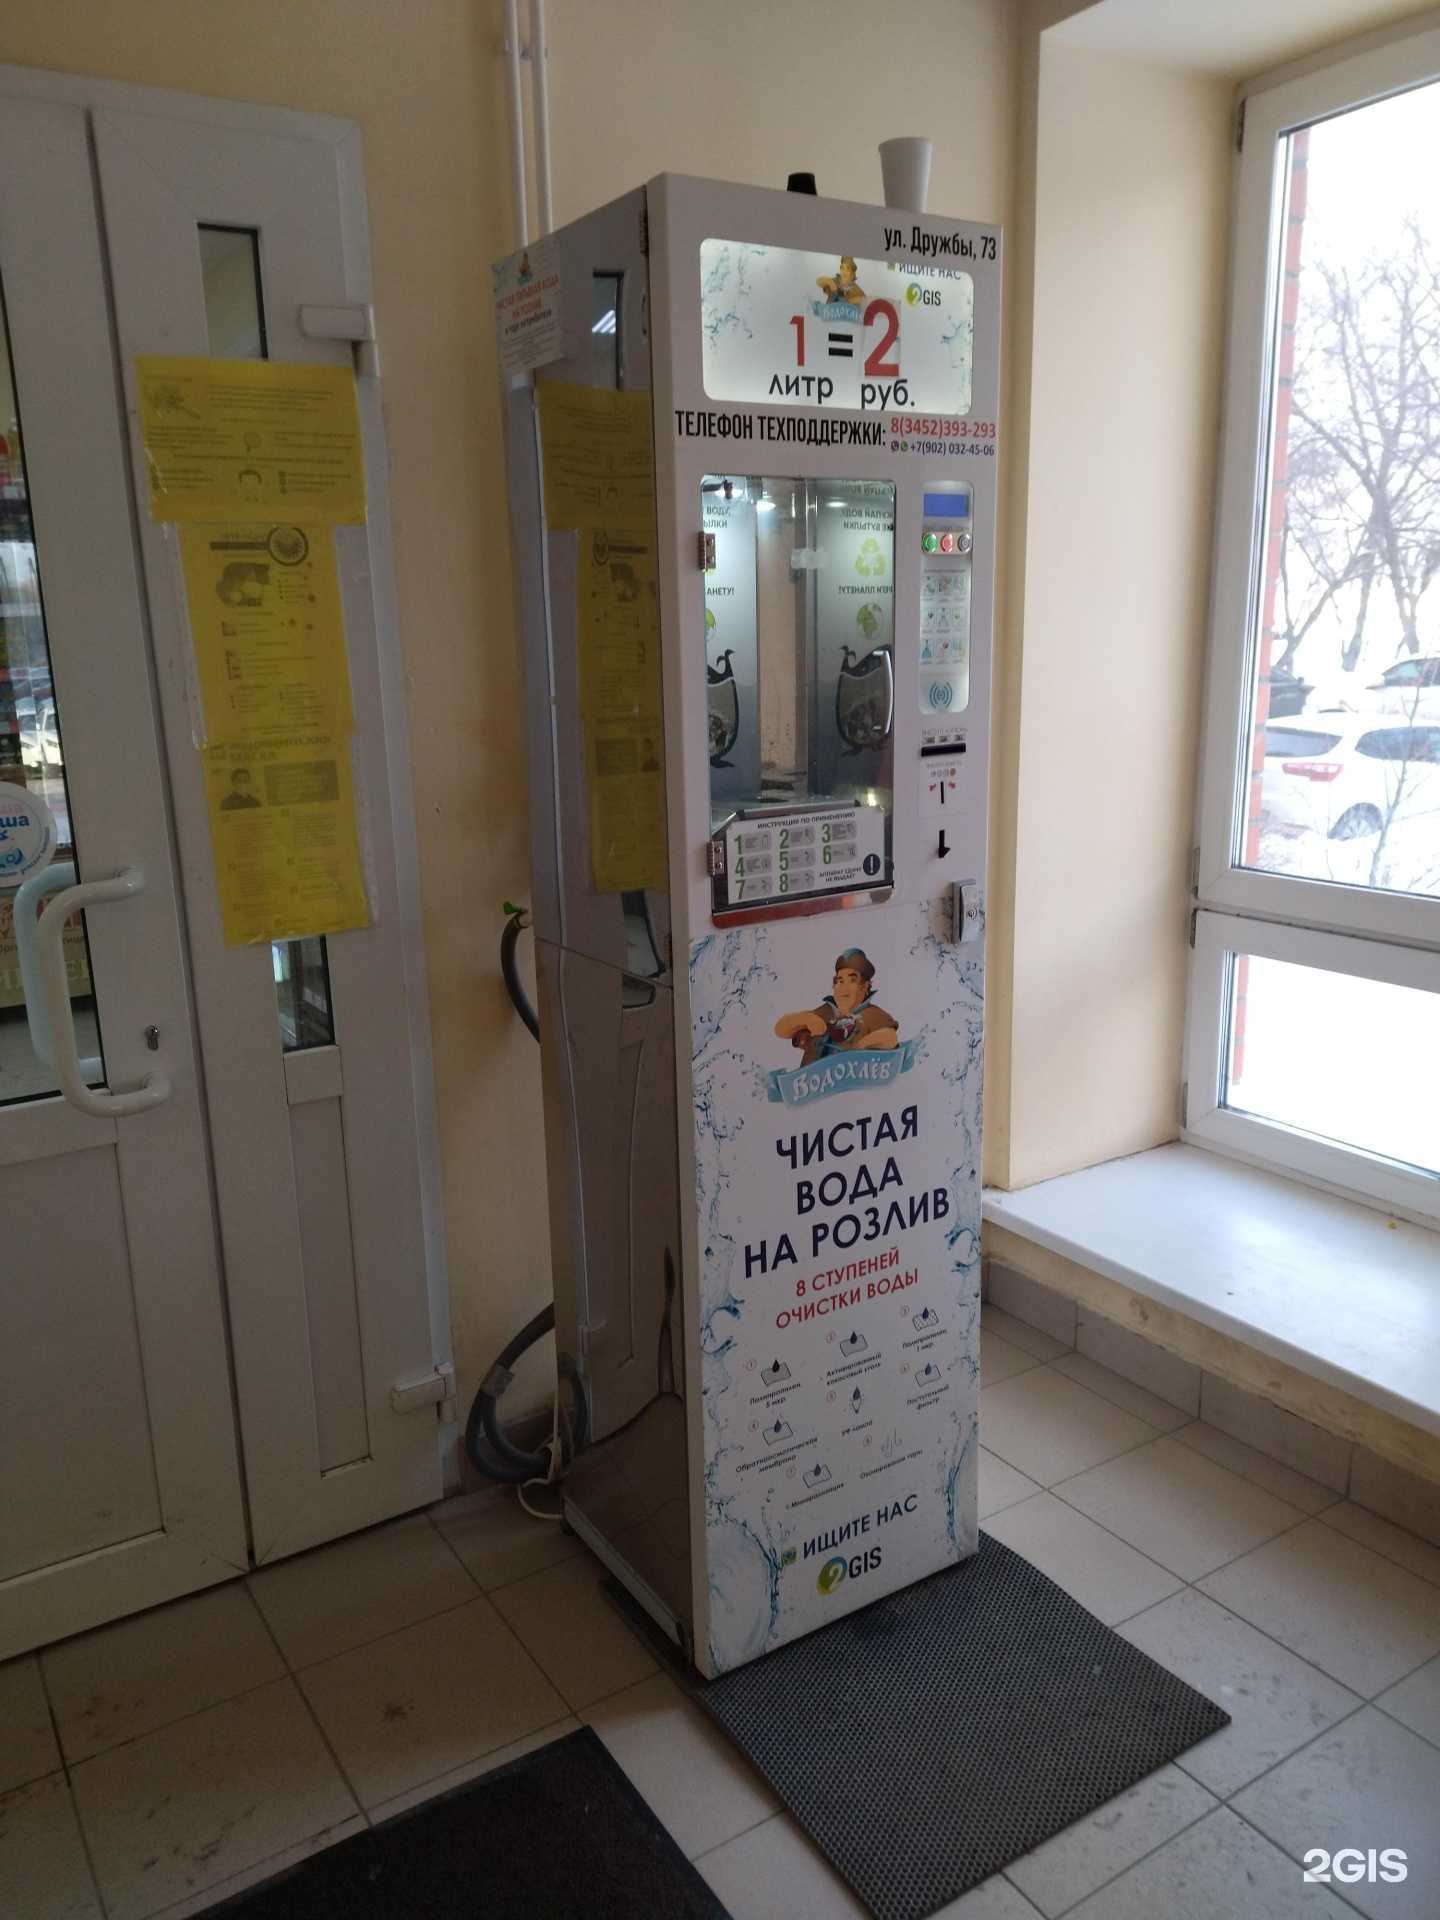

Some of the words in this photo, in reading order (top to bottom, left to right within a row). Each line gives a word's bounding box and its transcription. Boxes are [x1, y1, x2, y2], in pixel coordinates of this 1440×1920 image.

[884, 228, 906, 251] ул.
[911, 226, 977, 261] Дружбы,
[981, 235, 997, 261] 73
[790, 315, 805, 367] 1
[863, 298, 900, 377] 2
[769, 374, 834, 405] литр
[861, 379, 915, 411] руб.
[675, 410, 751, 439] ТЕЛЕФОН
[757, 416, 887, 446] ТЕХПОДДЕРЖКИ:
[890, 416, 997, 439] 8(3452)393-293
[910, 441, 947, 456] +7(902)
[948, 442, 995, 457] 032-45-06
[734, 835, 743, 855] 1
[779, 829, 789, 849] 2
[822, 823, 831, 843] 3
[735, 857, 745, 877] 4
[779, 851, 789, 871] 5
[822, 845, 832, 865] 6
[735, 879, 746, 900] 7
[779, 873, 789, 893] 8
[776, 1104, 918, 1170] ЧИСТАЯ
[797, 1156, 903, 1215] ВОДА
[744, 1233, 798, 1279] НА
[812, 1187, 950, 1258] РОЗЛИВ
[796, 1280, 806, 1297] 8
[812, 1246, 900, 1291] СТУПЕНЕЙ
[776, 1288, 861, 1329] ОЧИСТКИ
[867, 1268, 918, 1299] ВОДЫ
[804, 1514, 870, 1560] ИЩИТЕ
[877, 1494, 917, 1527] НАС
